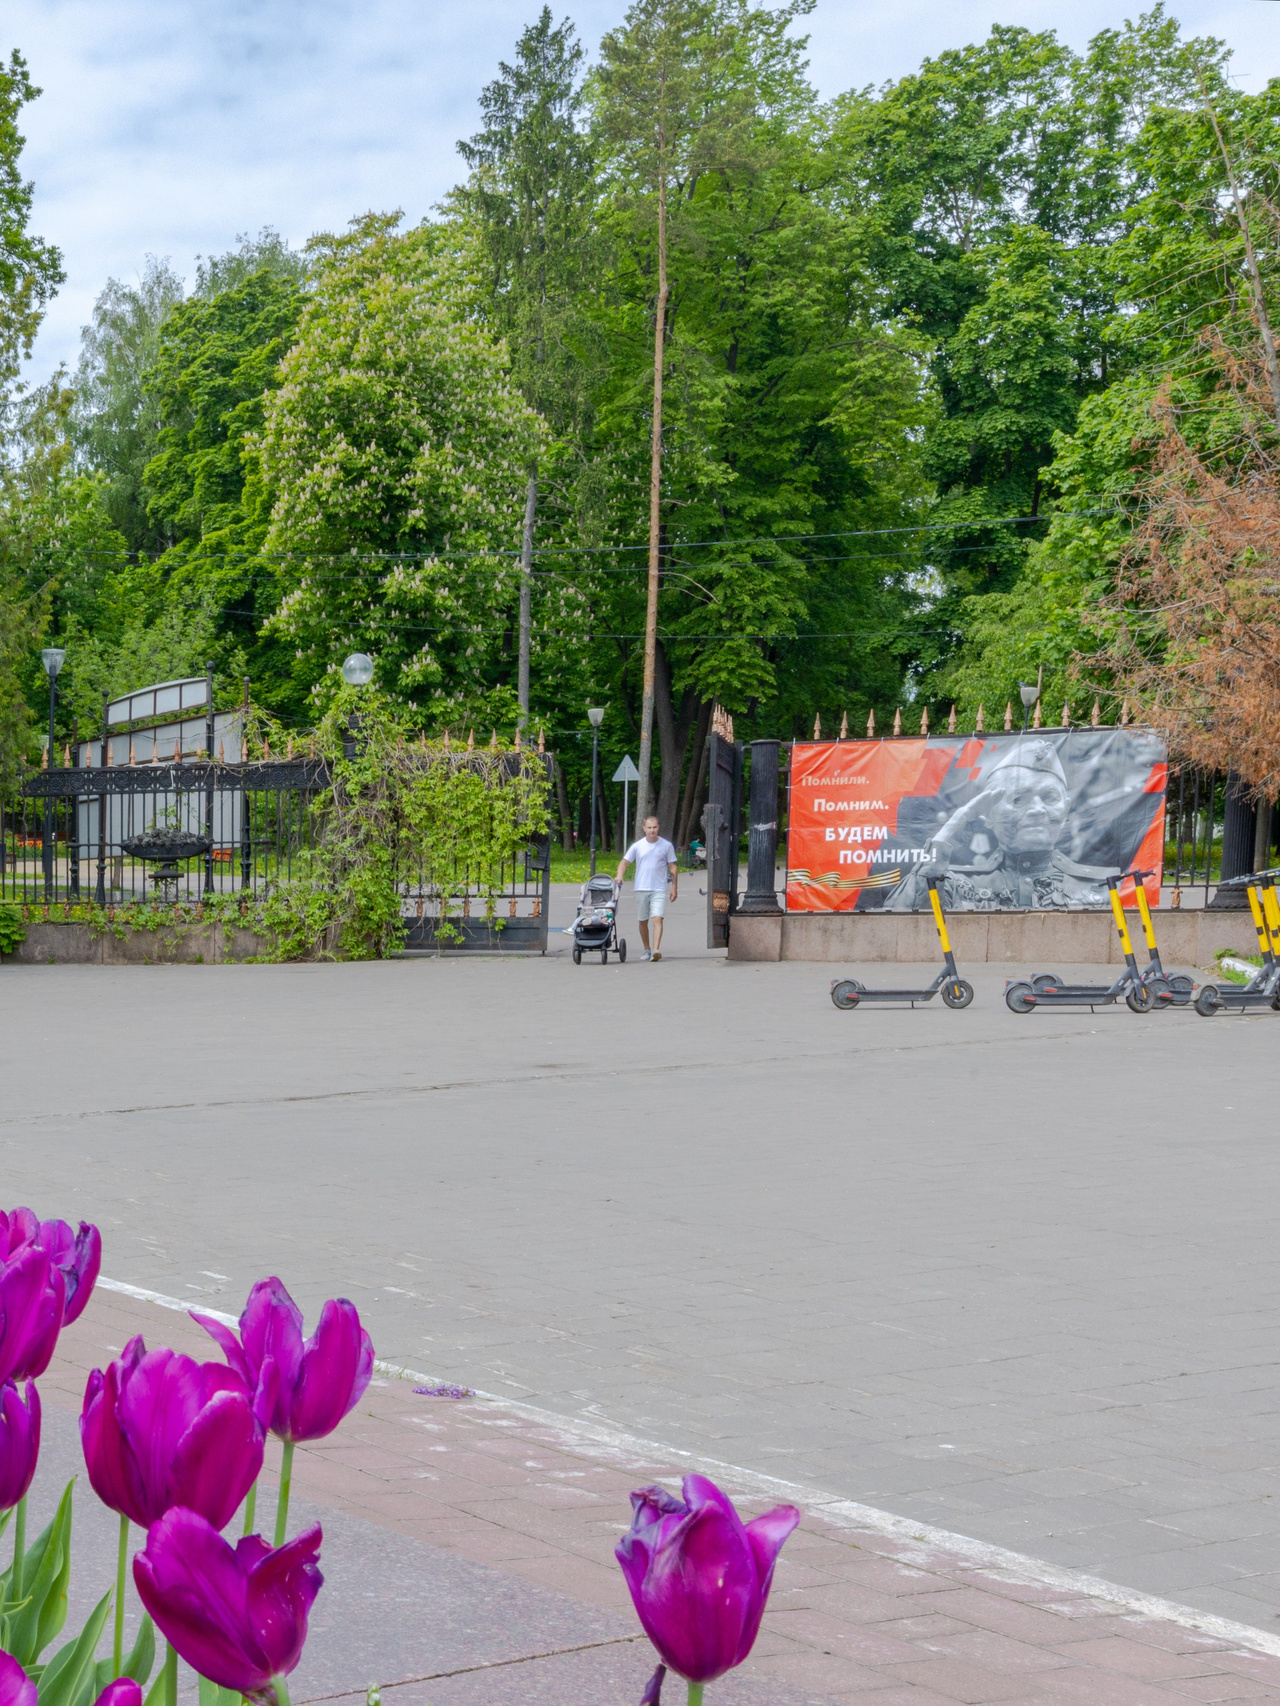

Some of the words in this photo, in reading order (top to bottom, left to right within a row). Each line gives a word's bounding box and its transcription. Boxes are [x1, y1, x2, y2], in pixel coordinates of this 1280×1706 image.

[801, 775, 870, 787] Помнили.
[814, 798, 889, 812] Помним.
[825, 826, 888, 843] БУДЕМ
[839, 848, 937, 864] ПОМНИТЬ!
